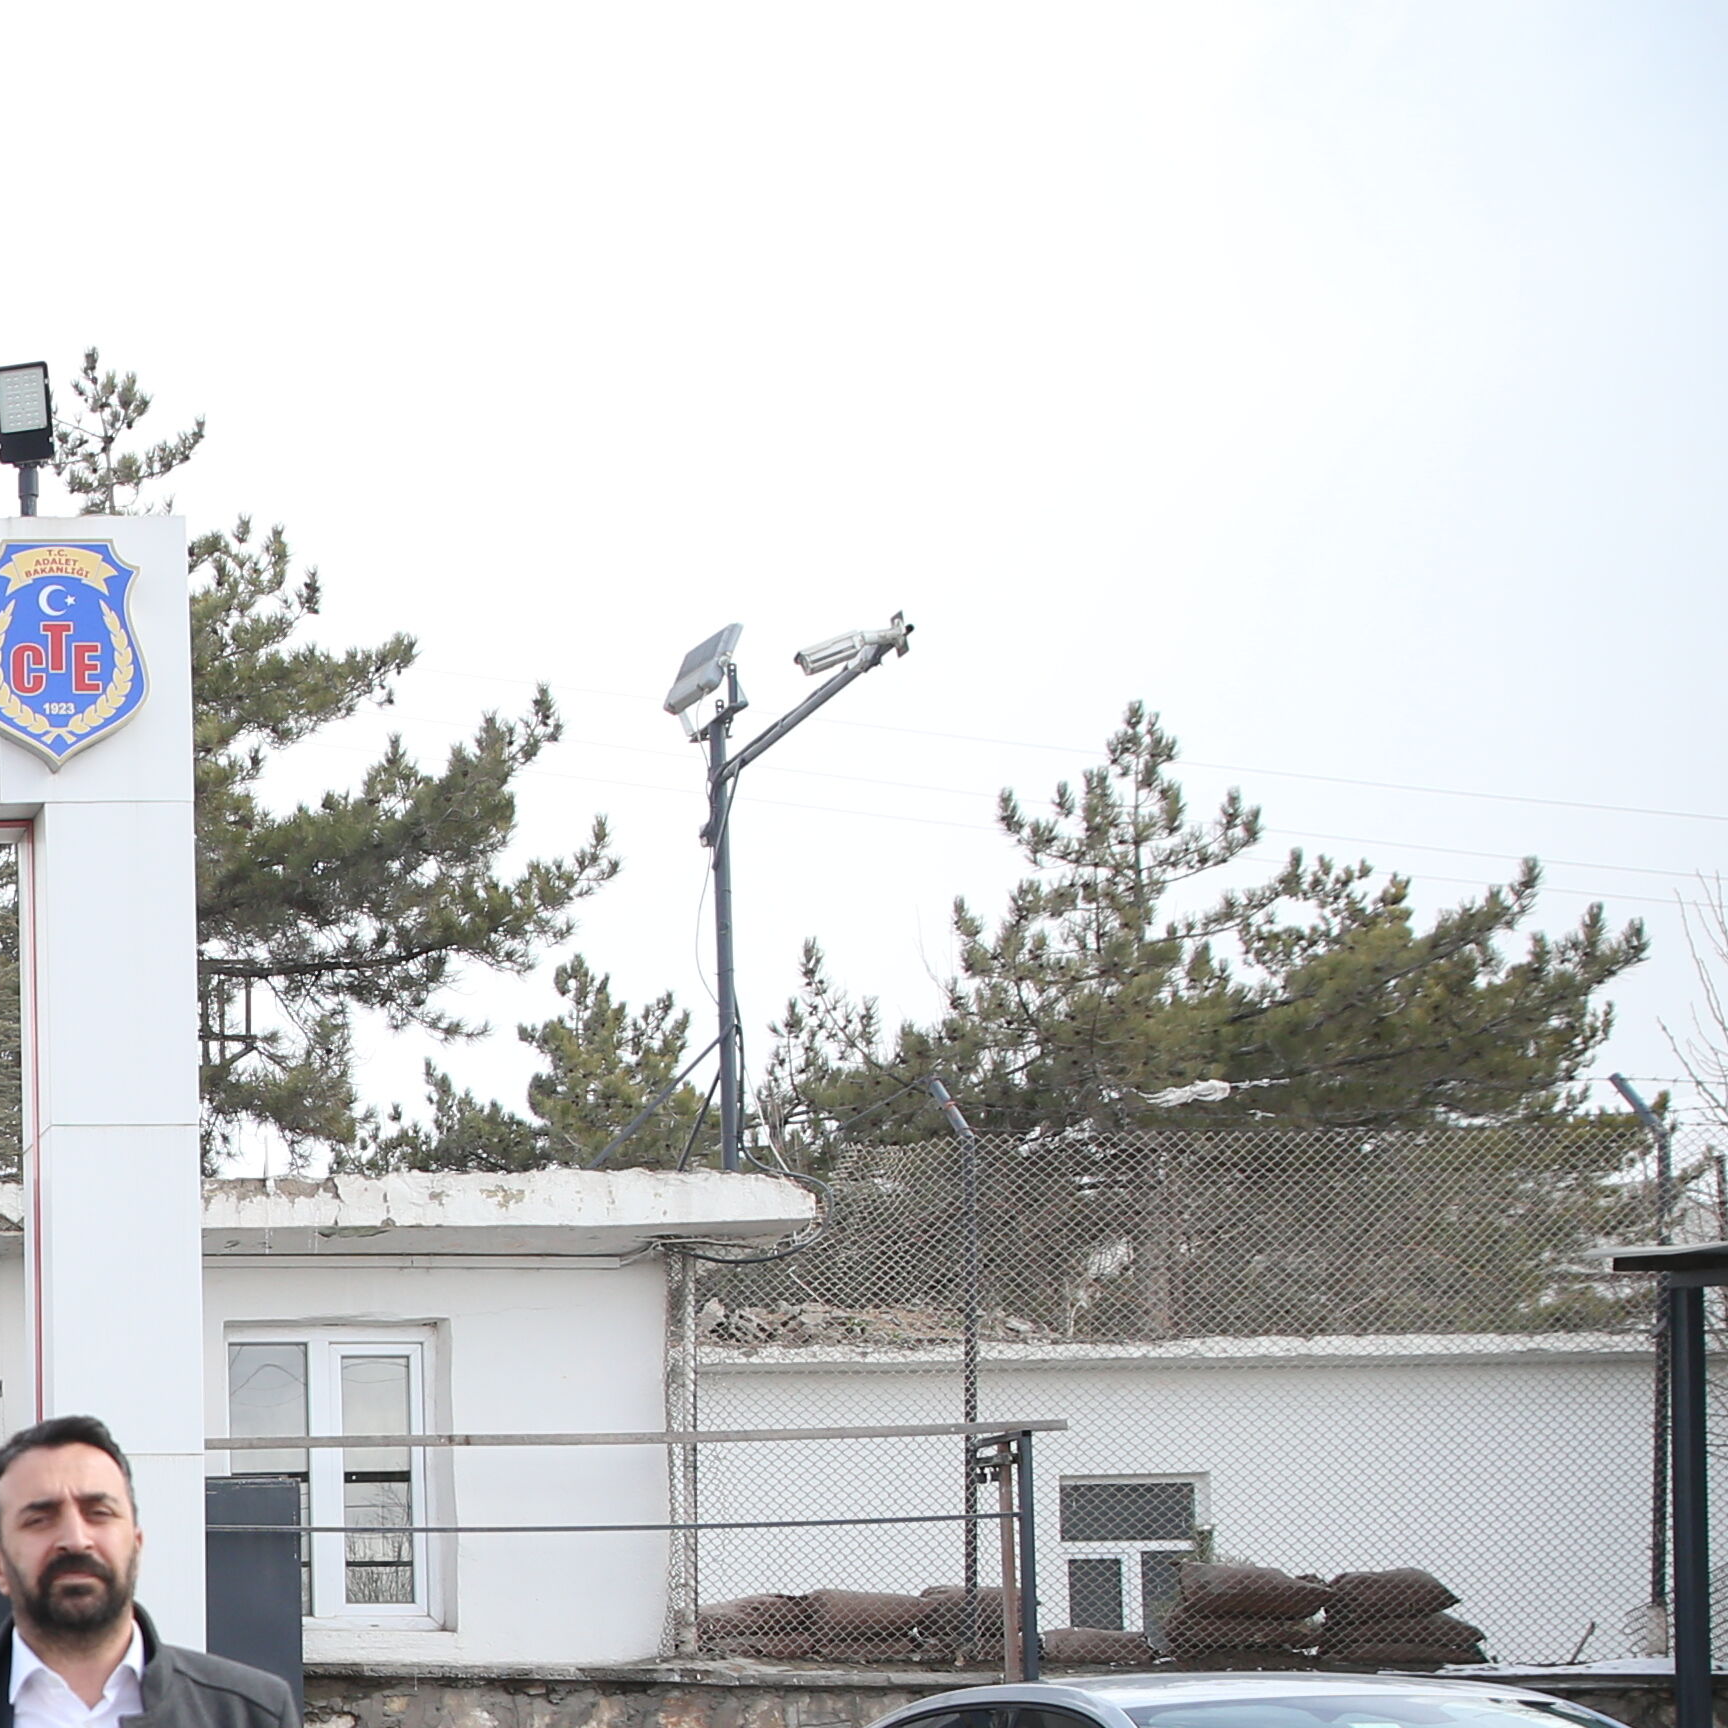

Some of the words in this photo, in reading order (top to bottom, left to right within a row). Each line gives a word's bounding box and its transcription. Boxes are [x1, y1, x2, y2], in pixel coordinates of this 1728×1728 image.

[34, 557, 79, 567] ADALET
[10, 621, 103, 697] CTE
[43, 702, 75, 715] 1923
